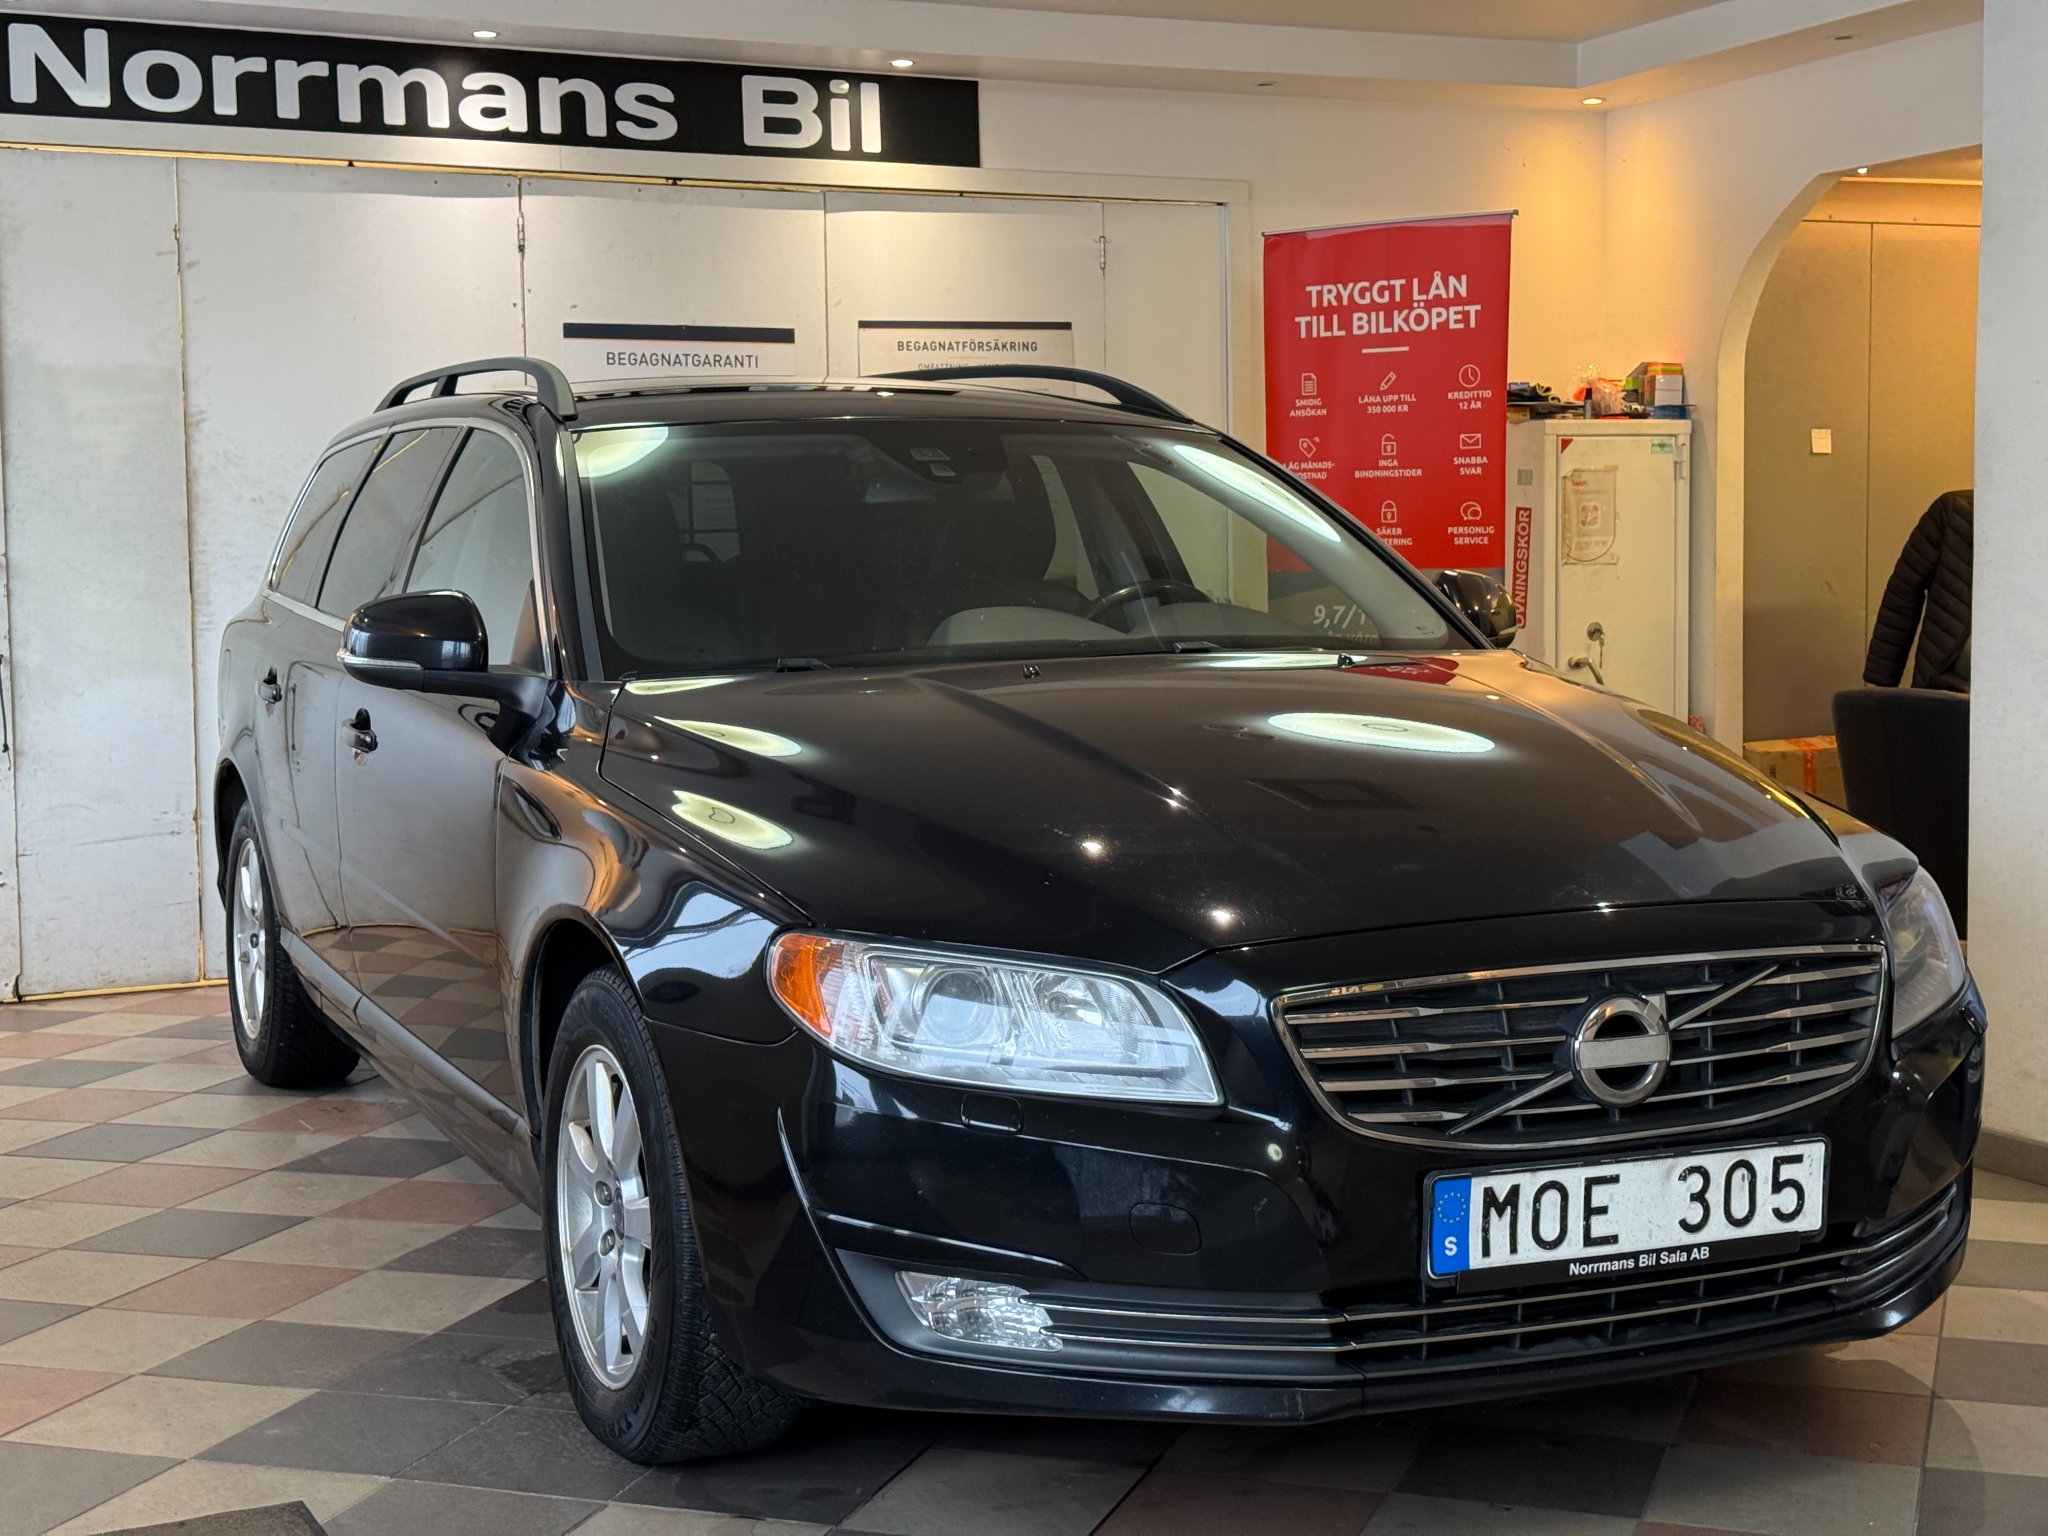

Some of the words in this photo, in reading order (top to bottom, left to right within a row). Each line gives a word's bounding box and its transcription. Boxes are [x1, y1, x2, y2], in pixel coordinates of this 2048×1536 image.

[6, 22, 679, 142] Norrmans
[741, 74, 883, 154] Bil
[1306, 279, 1406, 308] TRYGGT
[1413, 271, 1468, 301] LÅN
[1295, 314, 1346, 339] TILL
[1352, 302, 1482, 336] BILKÖPET
[897, 337, 1039, 353] BEGAGNATFÖRSÄKRING
[605, 351, 760, 369] BEGAGNATGARANTI
[1358, 393, 1381, 404] LÅNA
[1383, 394, 1399, 403] UPP
[1400, 393, 1417, 403] TILL
[1447, 390, 1492, 400] KREDITTID
[1295, 397, 1322, 407] SMIDIG
[1459, 402, 1467, 410] 12
[1467, 400, 1482, 410] ÅR
[1289, 407, 1327, 418] ANSÖKAN
[1366, 405, 1380, 414] 350
[1381, 404, 1395, 413] 000
[1397, 404, 1409, 412] KR
[1301, 459, 1335, 470] MÅNADS-
[1378, 459, 1399, 468] INGA
[1453, 456, 1488, 465] SNABBA
[1295, 471, 1328, 480] OSTNAD
[1354, 469, 1423, 479] BINDNINGSTIDER
[1459, 467, 1482, 476] SVAR
[1376, 525, 1403, 536] SÄKER
[1447, 526, 1495, 536] PERSONLIG
[1385, 537, 1413, 546] TERING
[1453, 536, 1489, 546] SERVICE
[1481, 1173, 1622, 1258] MOE
[1677, 1154, 1807, 1235] 305
[1443, 1236, 1458, 1257] S
[1568, 1255, 1636, 1276] Norrmans
[1638, 1253, 1656, 1268] Bil
[1659, 1249, 1688, 1265] Sala
[1689, 1245, 1710, 1261] AB
